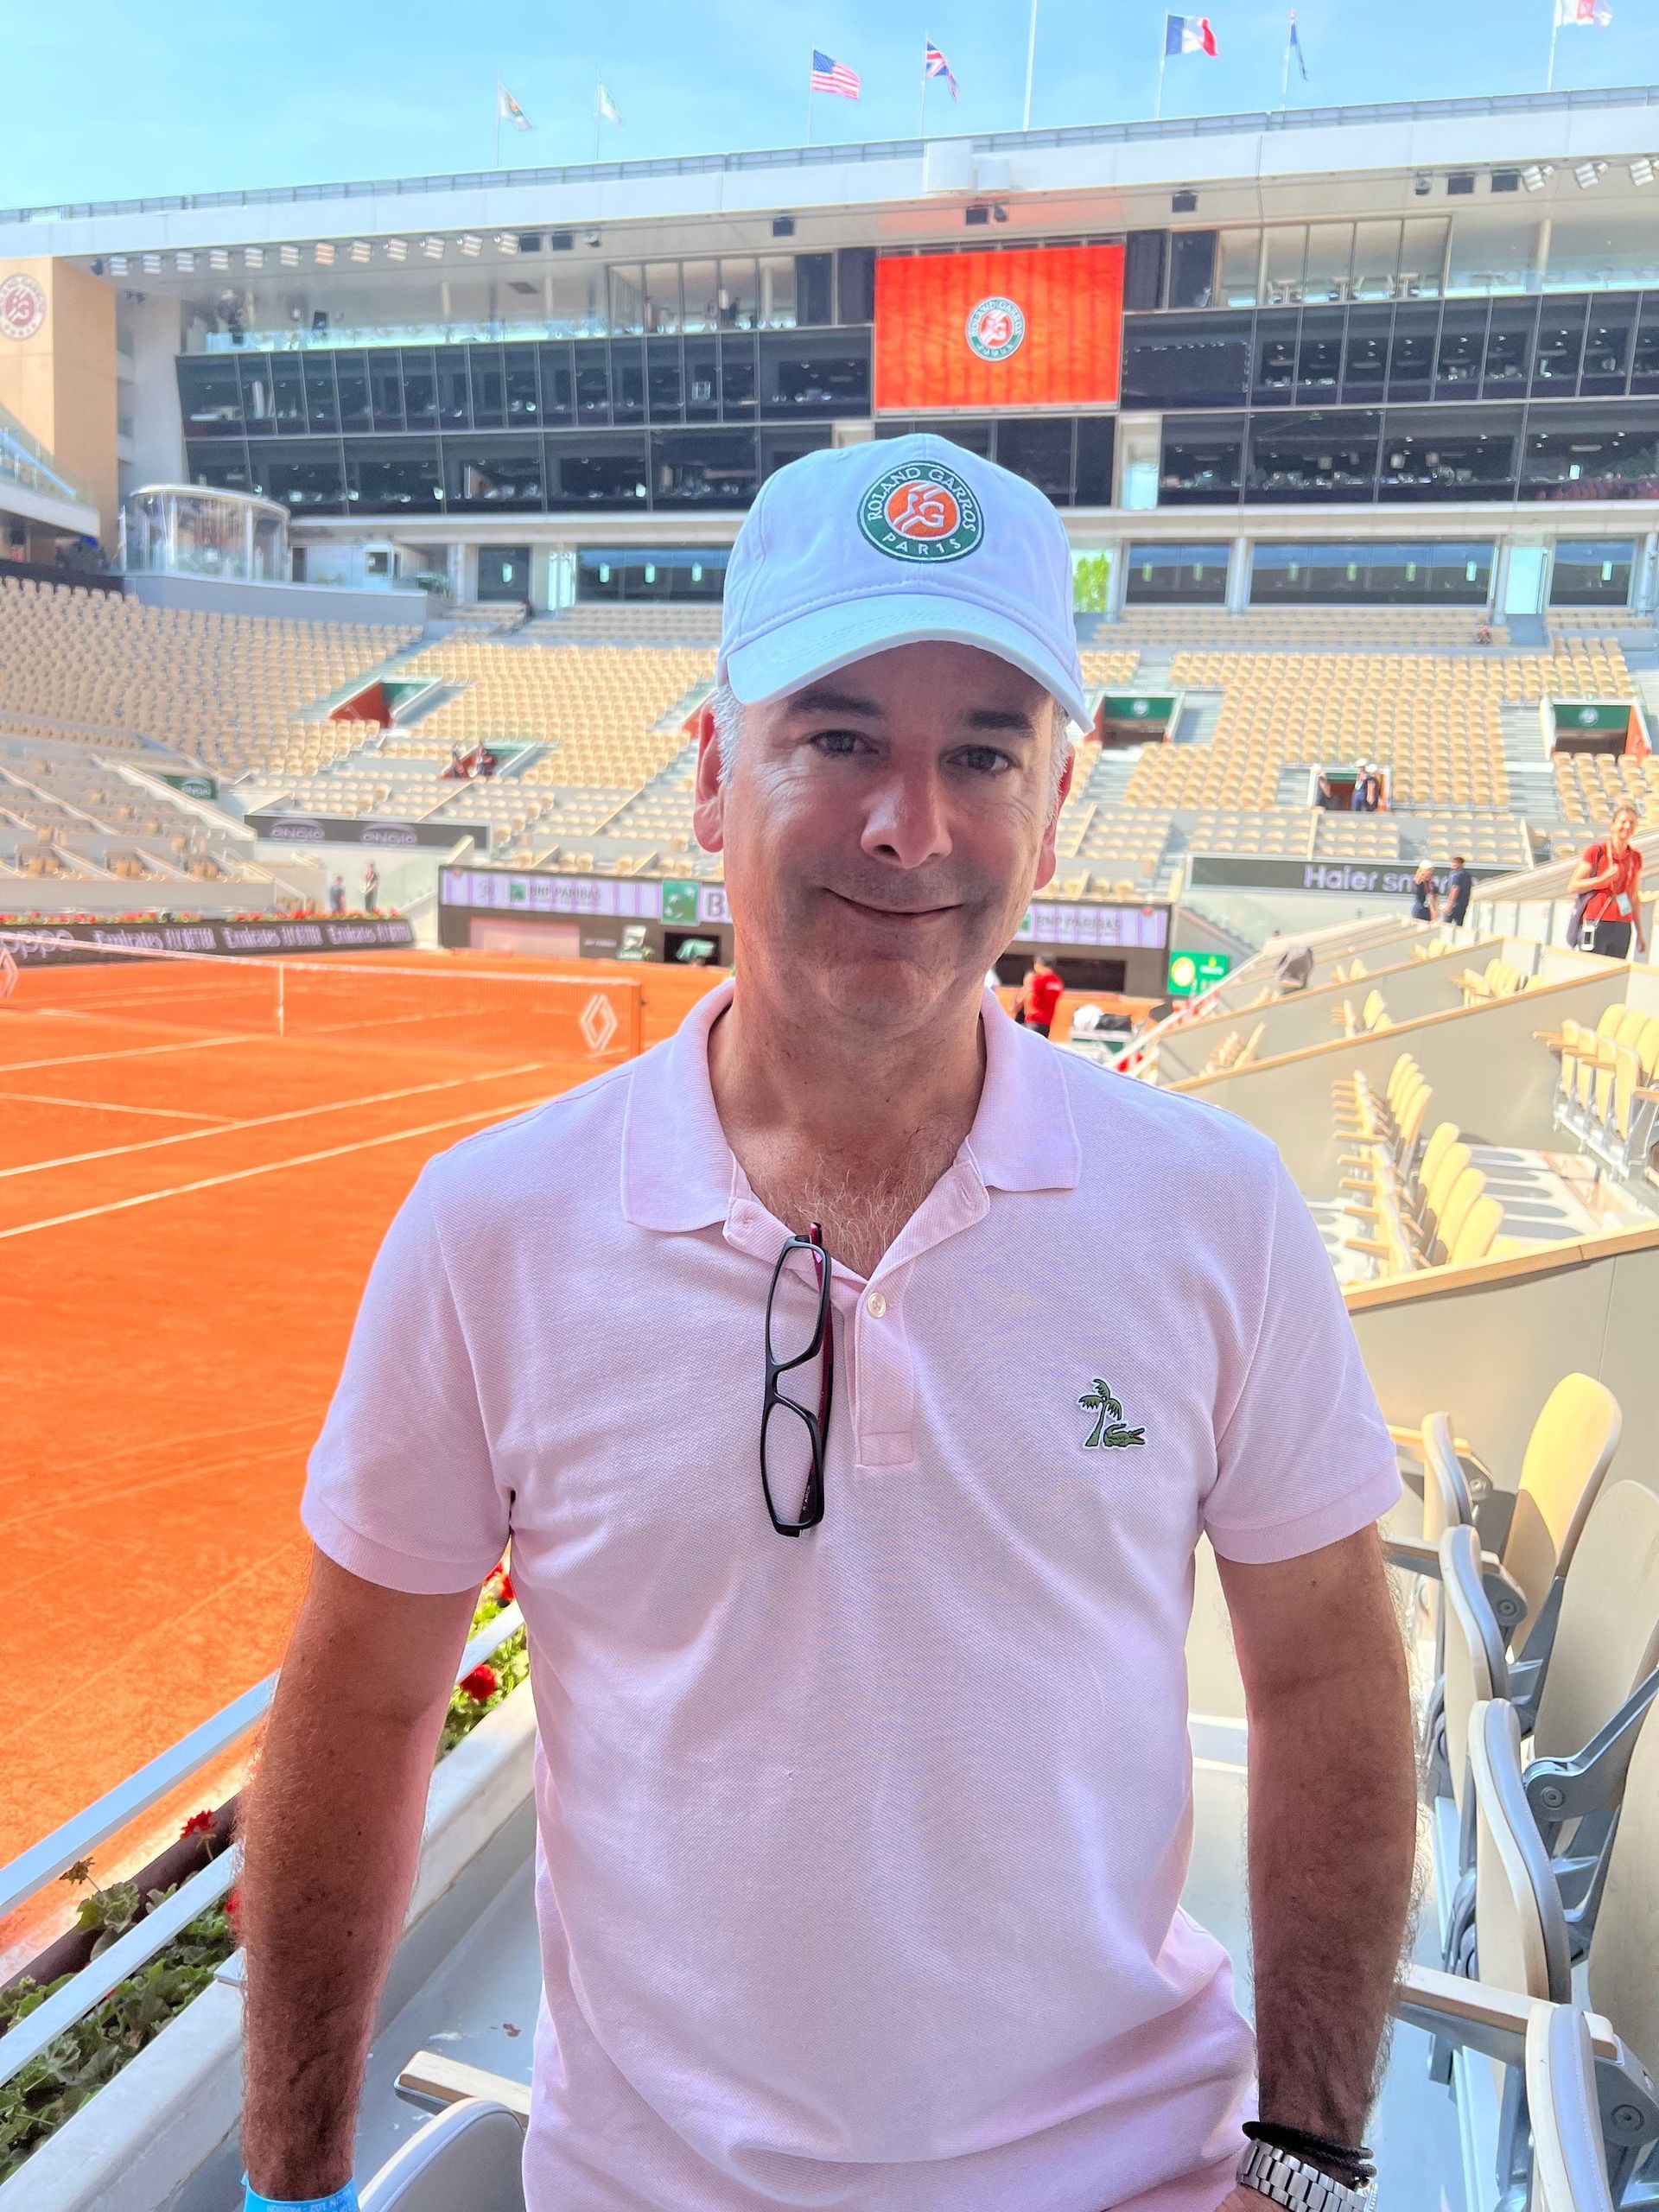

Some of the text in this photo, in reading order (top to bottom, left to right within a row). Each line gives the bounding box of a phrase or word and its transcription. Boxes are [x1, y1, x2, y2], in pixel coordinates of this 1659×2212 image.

[867, 467, 976, 532] ROLAND GARROS
[881, 532, 962, 555] PARIS
[1303, 865, 1380, 891] Haier
